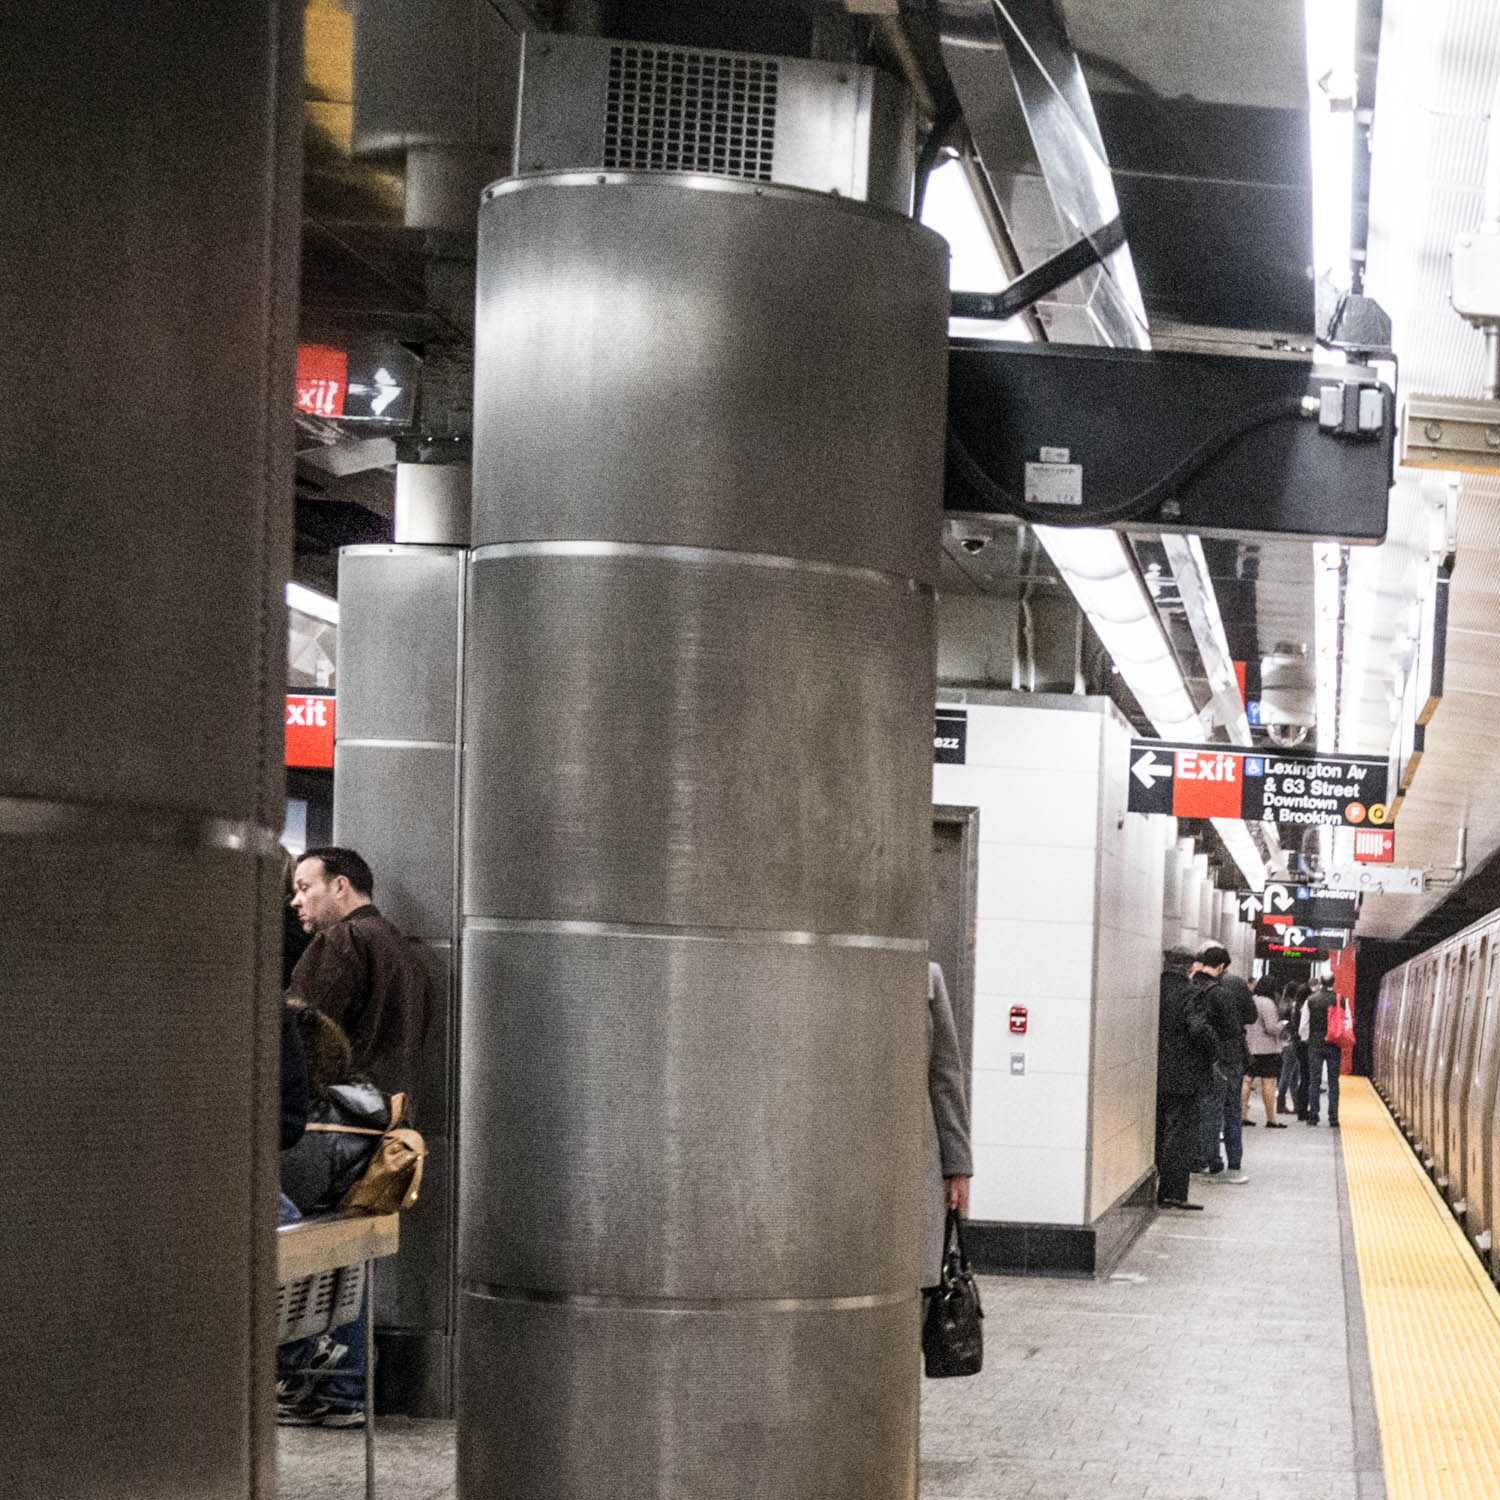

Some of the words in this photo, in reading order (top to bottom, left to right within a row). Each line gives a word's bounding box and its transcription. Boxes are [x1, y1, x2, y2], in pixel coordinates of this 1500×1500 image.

[286, 699, 327, 726] xit
[934, 737, 960, 749] ezz
[1176, 753, 1236, 782] Exit
[1264, 759, 1342, 779] Lexington
[1347, 764, 1368, 780] Av
[1264, 776, 1277, 792] &
[1282, 778, 1305, 794] 63
[1310, 779, 1360, 798] Street
[1262, 792, 1338, 810] Downtown
[1262, 807, 1274, 821] &
[1279, 808, 1342, 825] Brooklyn
